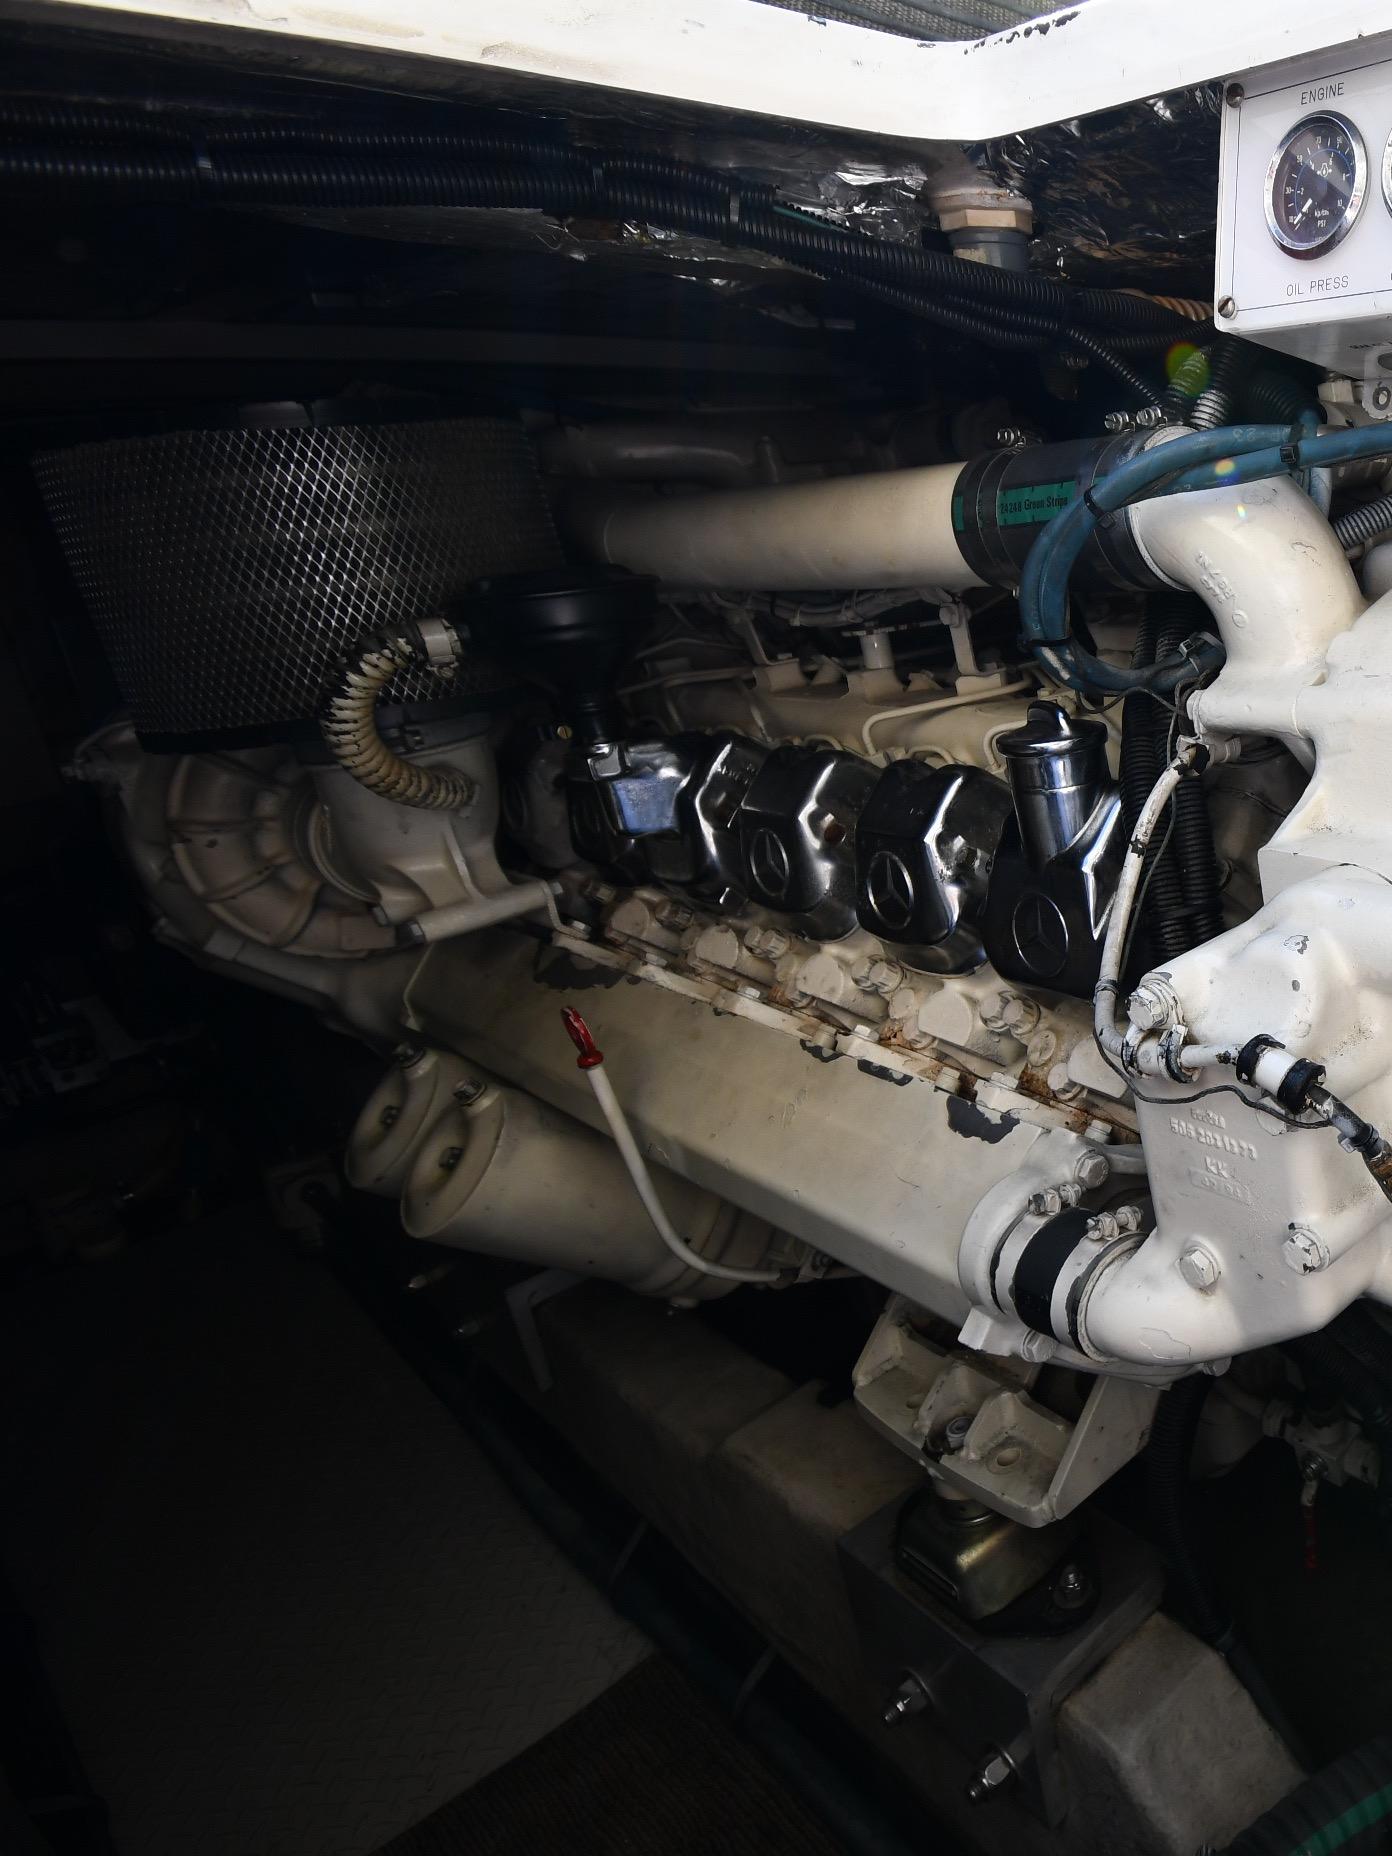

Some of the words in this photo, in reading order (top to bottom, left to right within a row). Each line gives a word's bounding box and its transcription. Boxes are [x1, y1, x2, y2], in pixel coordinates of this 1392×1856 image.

[1300, 82, 1345, 106] ENGINE
[1286, 283, 1304, 297] OIL
[1309, 275, 1349, 294] PRESS
[1024, 499, 1044, 511] Green
